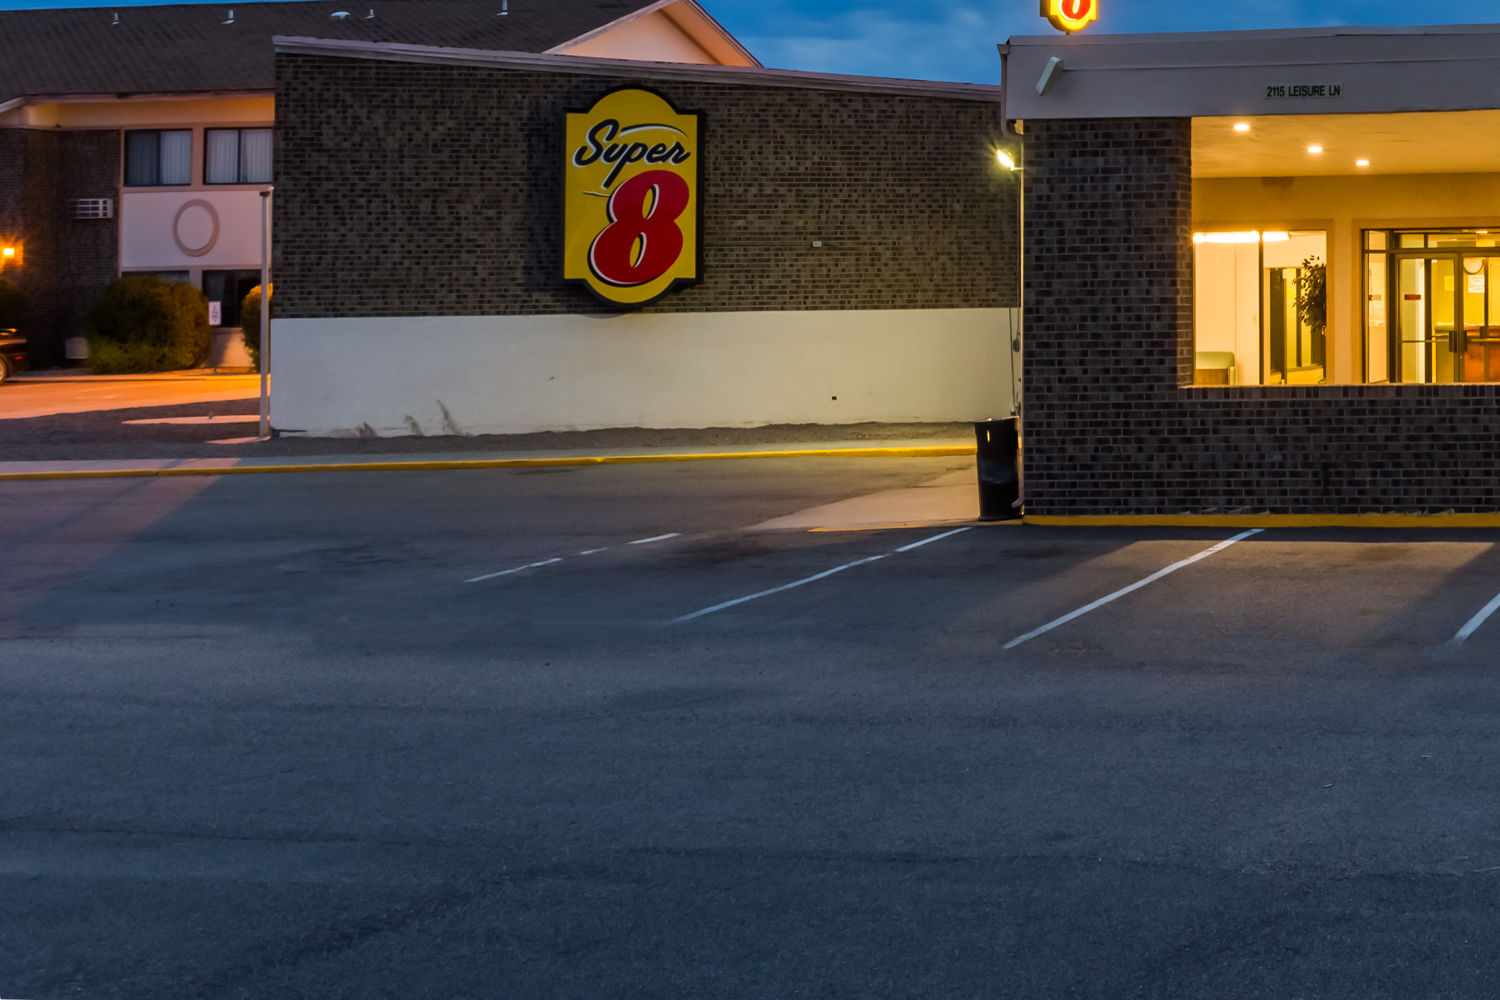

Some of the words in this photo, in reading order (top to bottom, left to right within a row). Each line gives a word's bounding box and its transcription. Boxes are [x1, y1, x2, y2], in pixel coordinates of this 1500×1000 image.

[1266, 85, 1285, 97] 2115
[1288, 85, 1325, 97] LEISURE
[1328, 84, 1341, 96] LN
[572, 118, 692, 190] Super
[587, 169, 691, 288] 8
